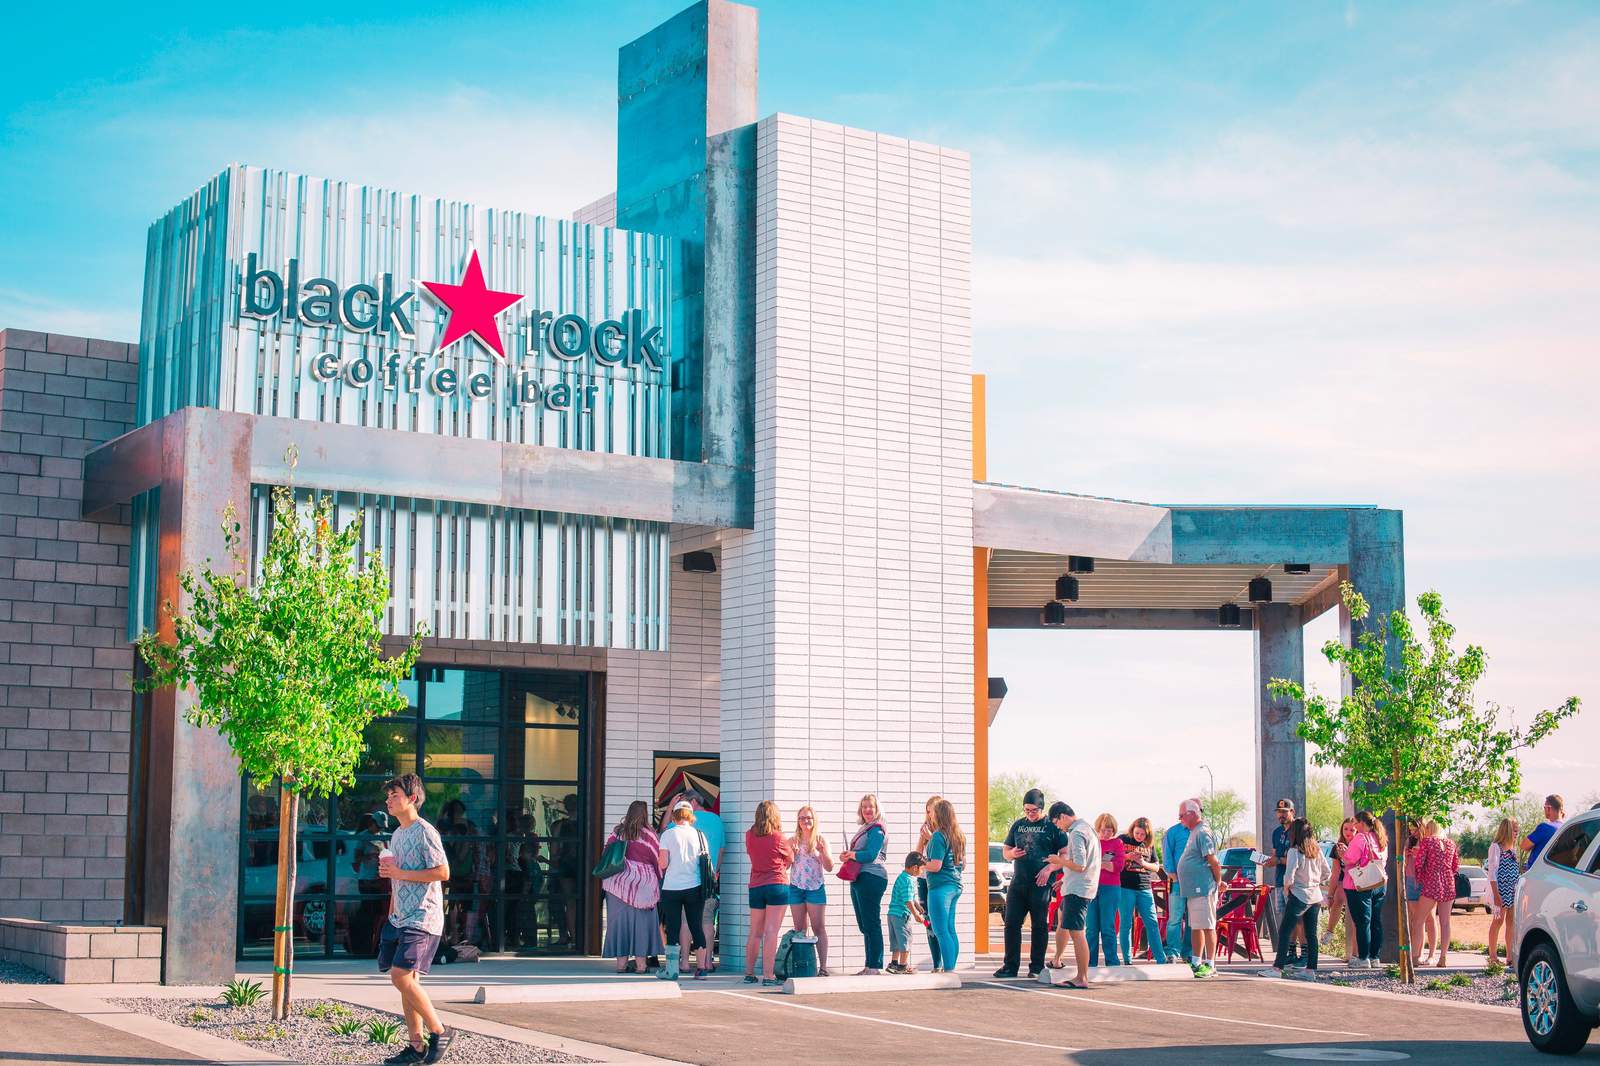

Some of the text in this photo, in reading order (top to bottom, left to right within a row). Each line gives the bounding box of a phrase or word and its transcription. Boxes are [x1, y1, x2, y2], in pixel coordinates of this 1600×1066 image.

[241, 252, 663, 371] black rock
[312, 352, 599, 412] coffee bar
